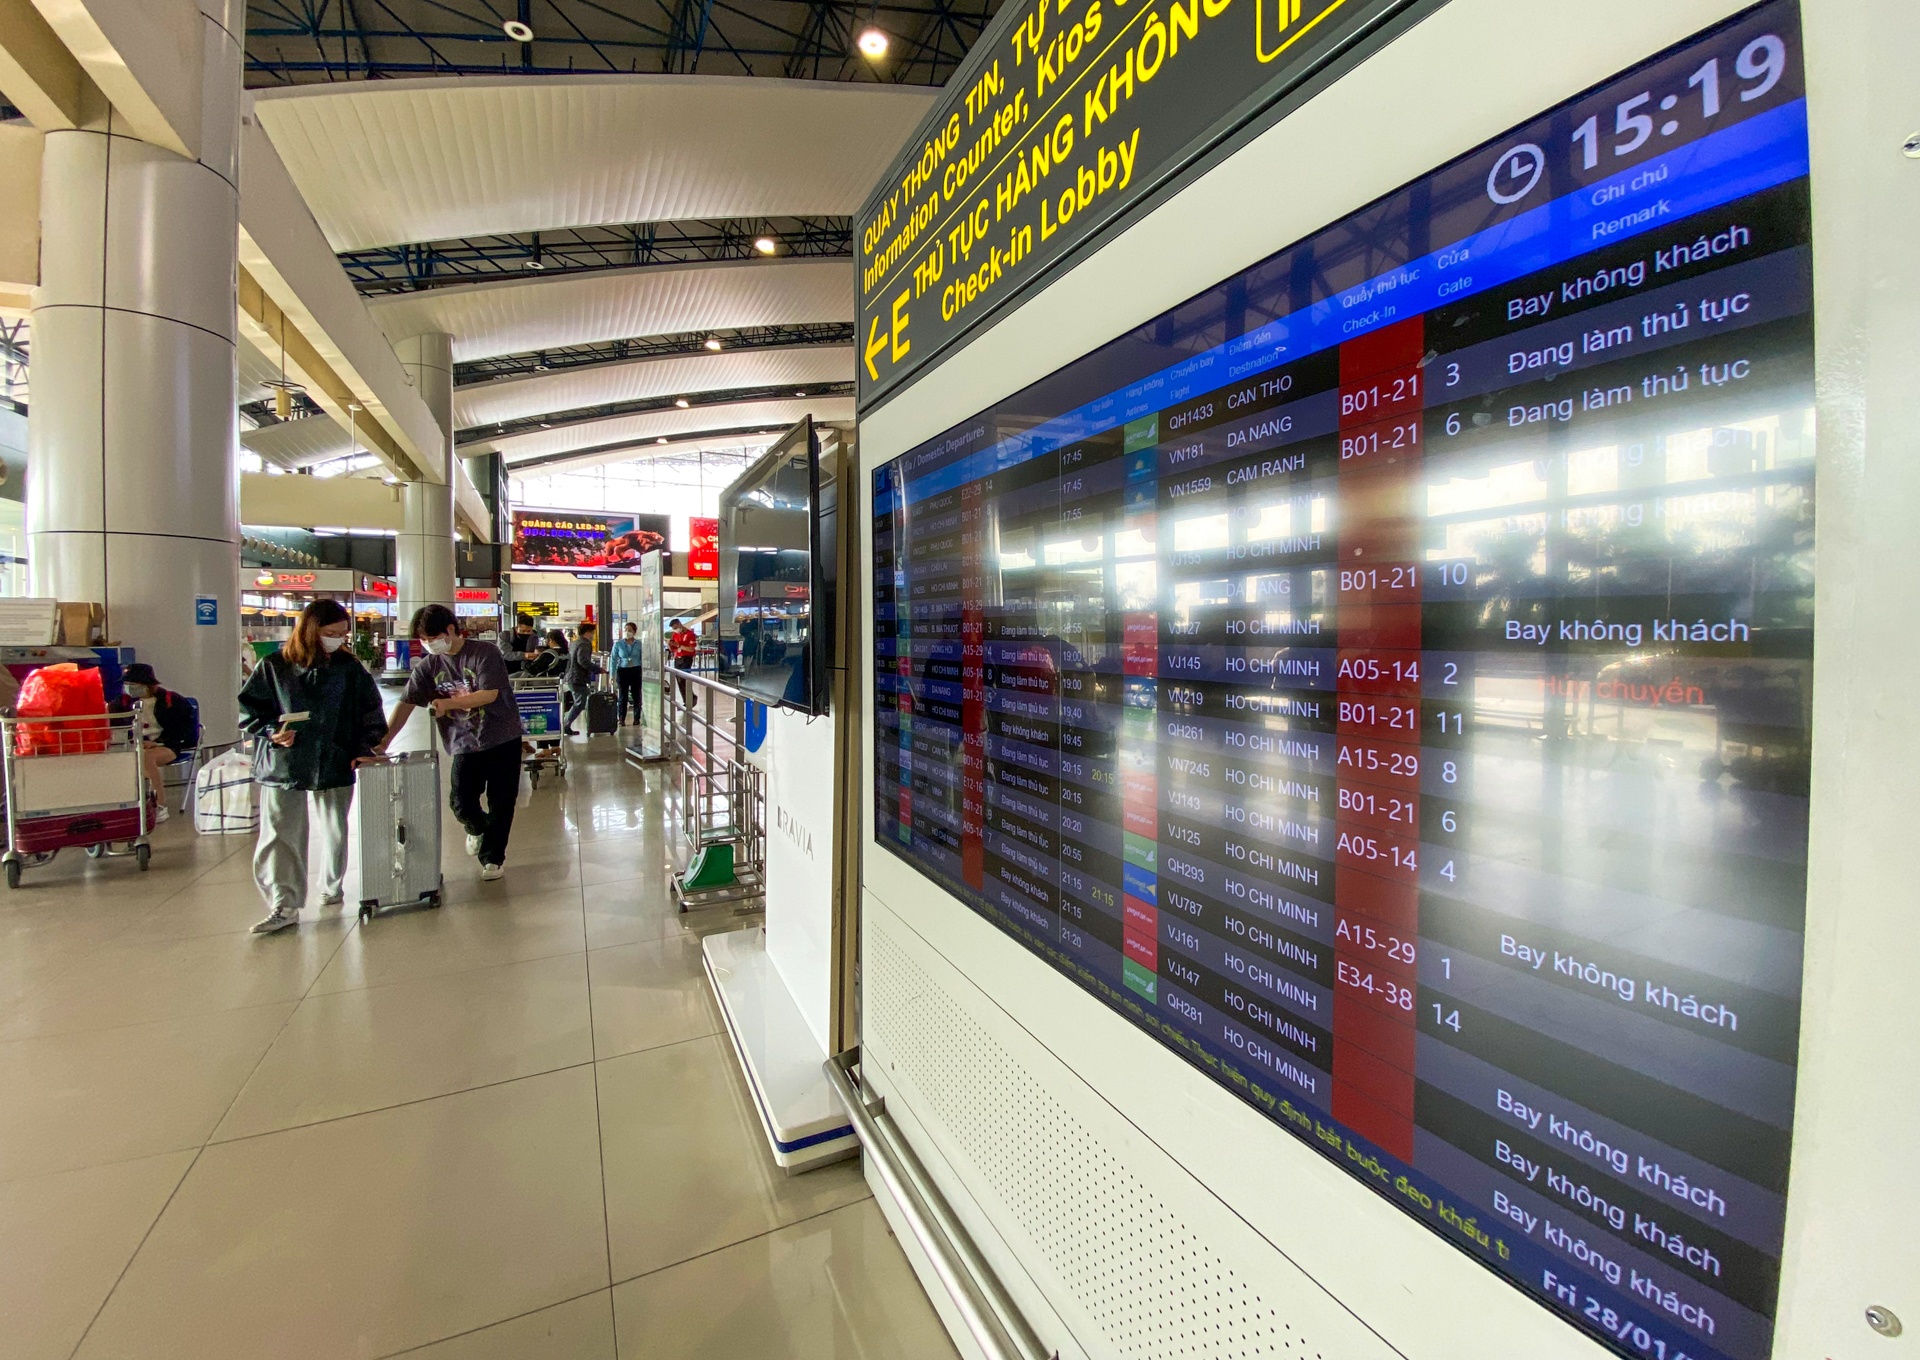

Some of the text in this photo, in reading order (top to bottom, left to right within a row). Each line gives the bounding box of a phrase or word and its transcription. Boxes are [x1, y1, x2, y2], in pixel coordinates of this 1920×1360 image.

[1572, 33, 1786, 172] 15:19
[901, 113, 961, 206] THÔNG
[964, 58, 1006, 128] TIN,
[863, 0, 1102, 295] Information Counter, Kios
[1591, 163, 1668, 208] Ghi chú
[913, 237, 943, 299] THỦ
[948, 199, 989, 264] TỤC
[996, 113, 1074, 222] HÀNG
[1592, 199, 1671, 241] Remark
[941, 127, 1140, 322] Check-in Lobby
[1437, 248, 1469, 270] Cửa
[1507, 225, 1749, 320] Bay không khách
[1377, 276, 1397, 295] thủ
[1400, 269, 1420, 284] tục
[1437, 274, 1473, 297] Gate
[891, 287, 911, 364] E
[1342, 305, 1396, 333] Check-In
[1508, 292, 1750, 374] Đang làm thủ tục
[1228, 350, 1279, 378] Destination
[1445, 361, 1461, 387] 3
[1170, 385, 1190, 400] Flight
[1227, 374, 1292, 410] CAN THO
[1342, 374, 1418, 417] B01-21
[1507, 359, 1750, 427] Đang làm thủ tục
[1169, 402, 1214, 430] QH1433
[1445, 412, 1461, 437] 6
[917, 426, 985, 465] Domestic Departures
[1227, 415, 1292, 448] DA NANG
[1342, 422, 1418, 460] B01-21
[1062, 450, 1082, 466] 17:45
[1168, 442, 1205, 465] VN181
[1226, 453, 1305, 485] CAM RANH
[1169, 477, 1212, 498] VN1559
[1340, 566, 1416, 591] B01-21
[1438, 563, 1468, 586] 10
[1505, 618, 1749, 647] Bay không khách
[962, 667, 983, 678] A05-14
[1168, 655, 1200, 670] VJ145
[1226, 657, 1320, 676] HO CHI MINH
[1338, 659, 1420, 682] A05-14
[1443, 662, 1458, 685] 2
[1168, 689, 1203, 705] VN219
[1339, 701, 1415, 730] B01-21
[1437, 711, 1462, 735] 11
[1168, 723, 1203, 740] QH261
[1225, 731, 1319, 760] HO CHI MINH
[1168, 756, 1210, 778] VN7245
[1337, 745, 1418, 776] A15-29
[1442, 761, 1457, 783] 8
[1092, 769, 1113, 784] 20:15
[1168, 790, 1200, 810] VJ143
[1339, 788, 1414, 824] B01-21
[1062, 817, 1082, 833] 20:20
[1168, 822, 1201, 846] VJ125
[1441, 810, 1457, 833] 6
[1225, 842, 1319, 886] HO CHI MINH
[1337, 832, 1417, 872] A05-14
[1168, 858, 1204, 883] QH293
[1440, 860, 1456, 882] 4
[1092, 887, 1114, 907] 21:15
[1167, 890, 1202, 917] VU787
[1062, 928, 1082, 948] 21:20
[1167, 924, 1200, 952] VJ161
[1225, 916, 1318, 969] HO CHI MINH
[1336, 919, 1416, 964] A15-29
[1167, 958, 1200, 986] VJ147
[1441, 958, 1450, 980] 1
[1500, 933, 1738, 1032] Bay không khách
[1337, 961, 1413, 1011] E34-38
[1167, 993, 1202, 1025] QH281
[1224, 989, 1316, 1052] HO CHI MINH
[1432, 1003, 1462, 1033] 14
[1224, 1025, 1315, 1094] HO CHI MINH
[1496, 1088, 1727, 1218] Bay không khách
[1395, 1175, 1432, 1209] đeo
[1494, 1139, 1721, 1277] Bay không khách
[1493, 1190, 1716, 1336] Bay không khách
[1543, 1269, 1576, 1306] Fri
